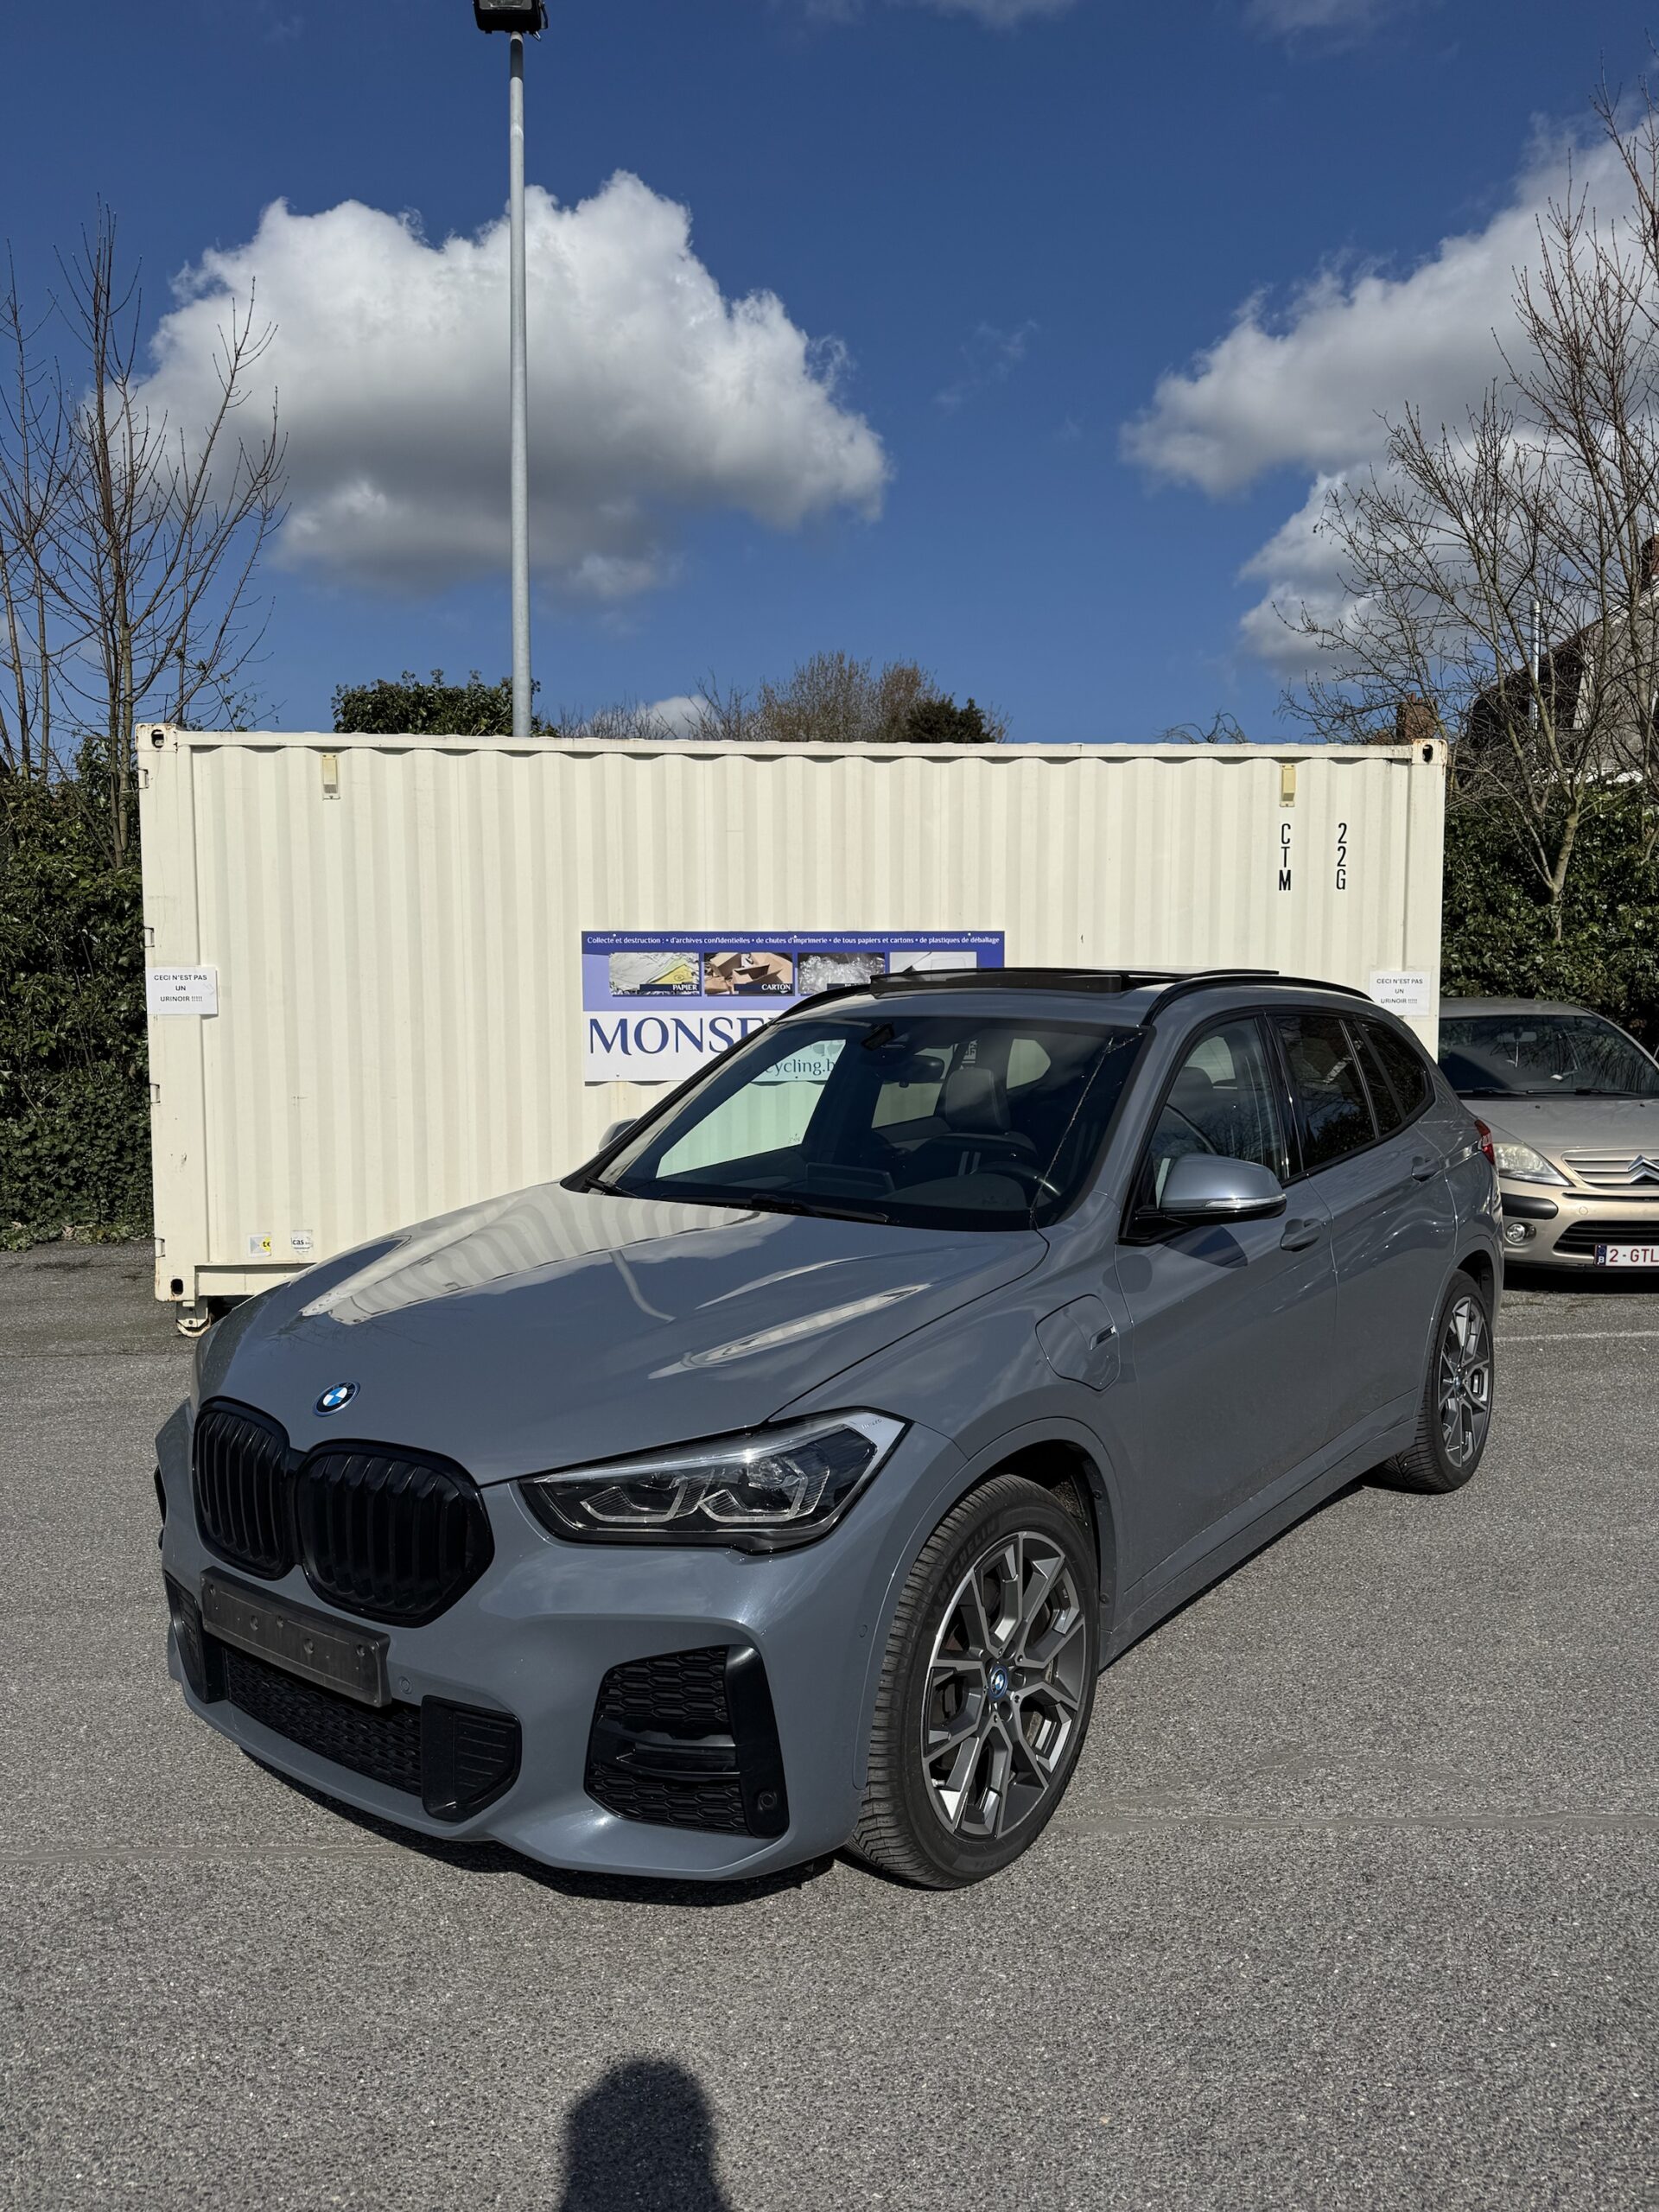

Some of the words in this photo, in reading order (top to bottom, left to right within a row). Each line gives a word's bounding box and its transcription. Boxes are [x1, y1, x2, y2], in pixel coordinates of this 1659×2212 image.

[788, 937, 827, 945] d'imprimerie
[857, 937, 881, 945] papiers
[928, 937, 961, 945] plastiques
[969, 937, 1000, 945] déballage
